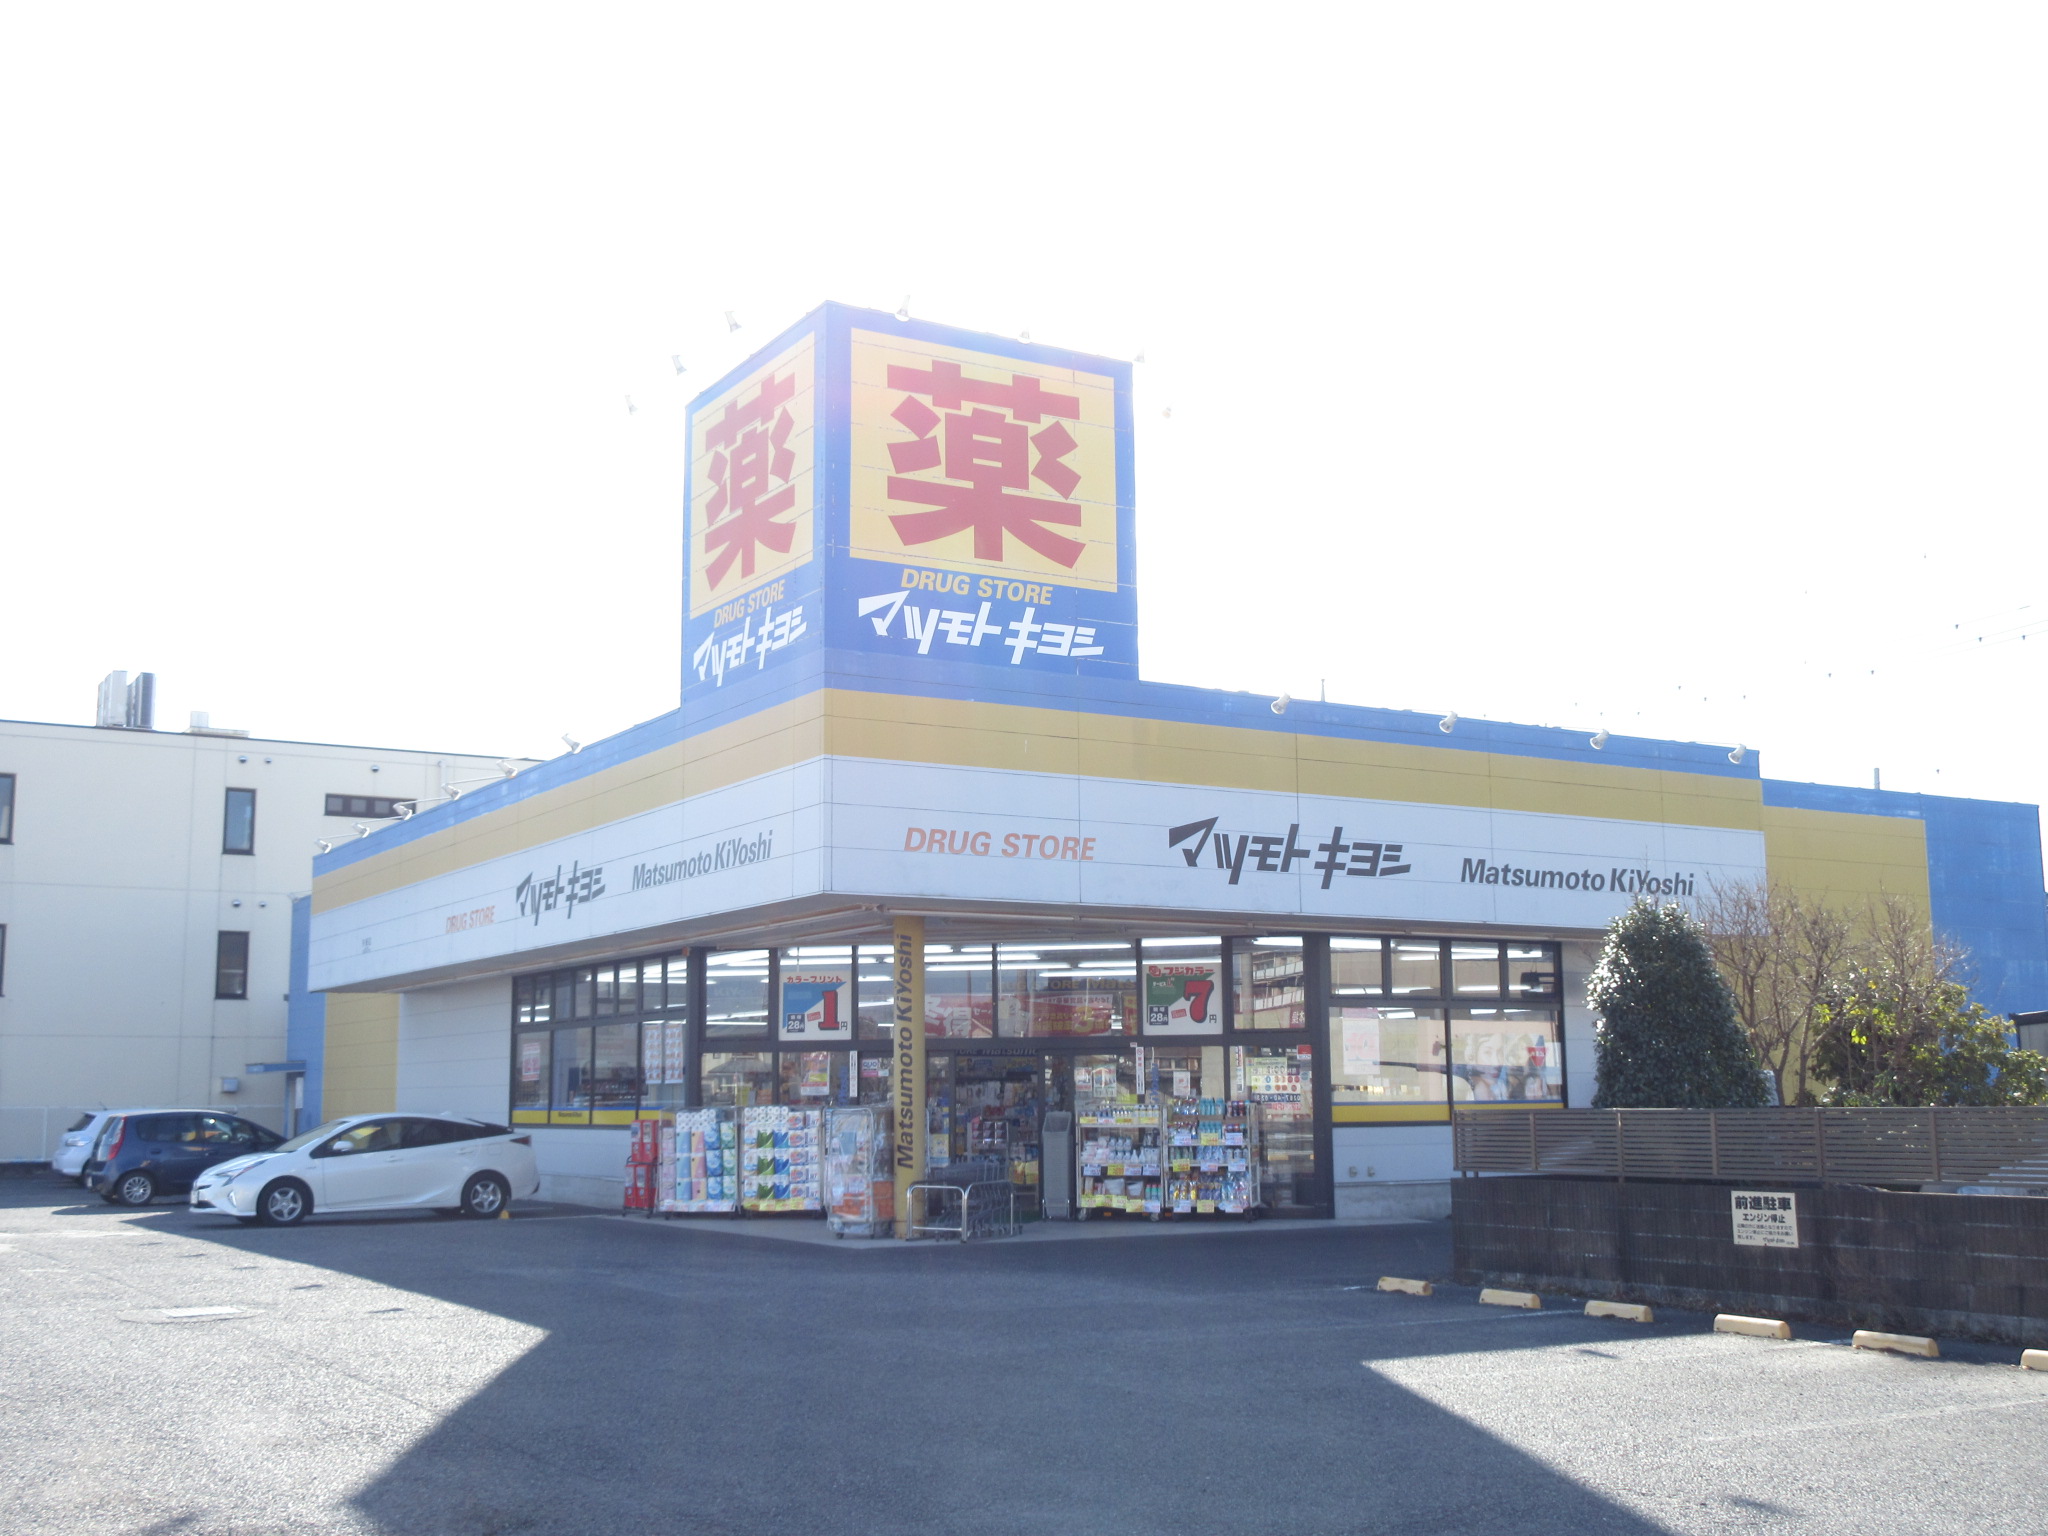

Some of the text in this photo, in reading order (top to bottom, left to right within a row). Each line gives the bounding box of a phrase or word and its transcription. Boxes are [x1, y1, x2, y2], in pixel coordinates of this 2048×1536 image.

[705, 372, 796, 591] 薬
[887, 360, 1086, 569] 薬
[714, 579, 785, 628] DRUG STORE
[901, 569, 1054, 606] DRUG STORE
[693, 605, 808, 687] マツモトキヨシ
[858, 590, 1105, 665] マツモトキヨシ
[632, 830, 773, 891] Matsumoto KiYoshi
[904, 826, 1096, 863] DRUG STORE
[1168, 816, 1412, 890] マツモトキヨシ
[516, 860, 606, 926] マツモトキヨシ
[1461, 856, 1694, 897] Matsumoto KiYoshi
[445, 905, 496, 935] DRUG STORE
[786, 975, 842, 984] カラープリント
[1163, 966, 1214, 976] フジカラー
[897, 934, 914, 1169] Matsumoto KiYoshi
[1735, 1196, 1792, 1211] 前進駐車
[1742, 1213, 1785, 1223] エンジン停止
